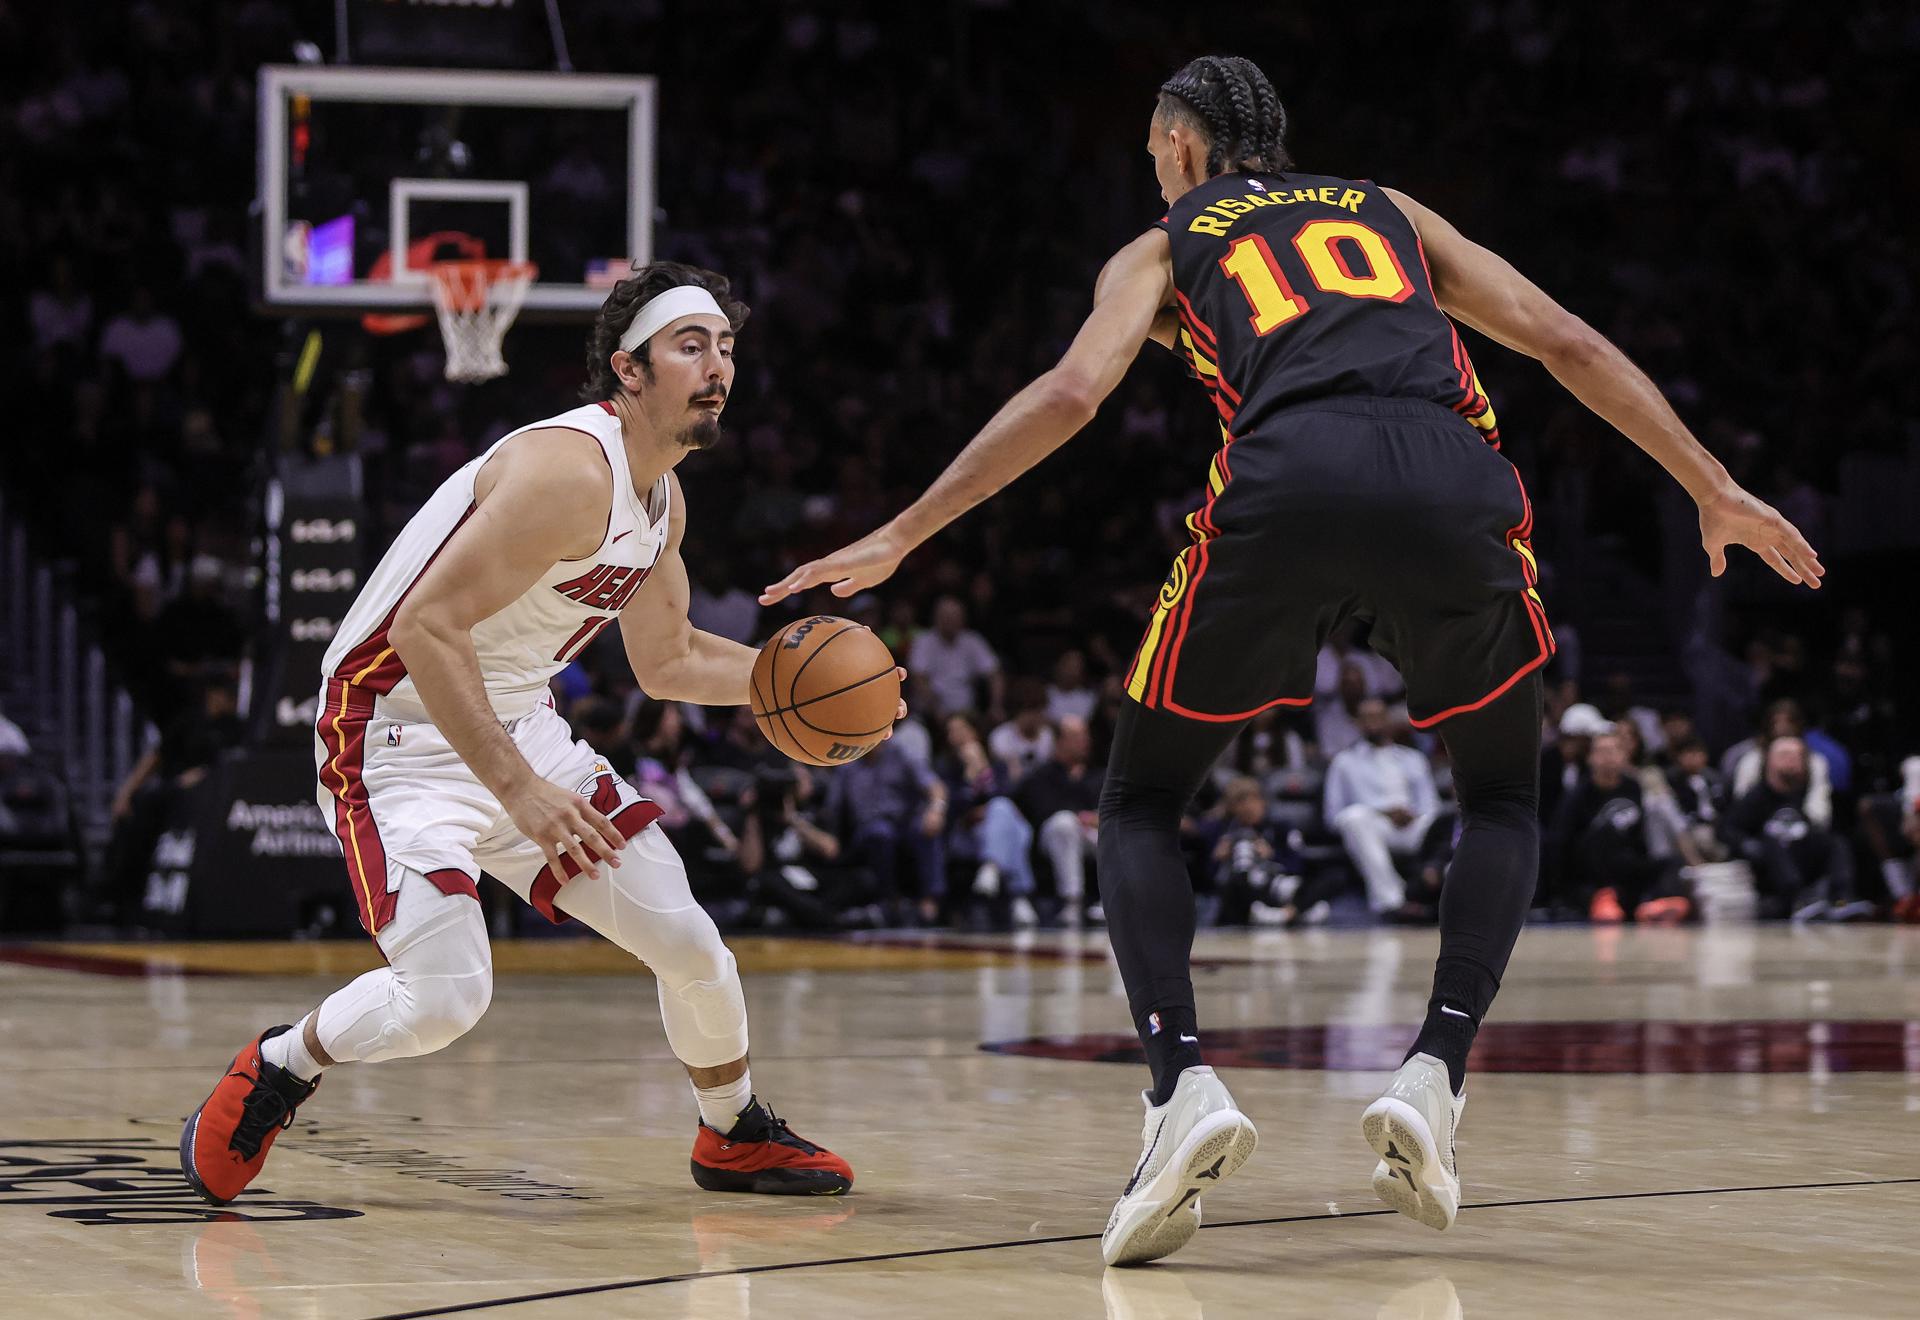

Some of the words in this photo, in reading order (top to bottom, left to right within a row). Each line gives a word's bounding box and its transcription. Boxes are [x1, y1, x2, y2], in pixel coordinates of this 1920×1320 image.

[1188, 187, 1366, 238] RISACHER
[1218, 218, 1416, 338] 10
[227, 799, 327, 831] Americ
[251, 828, 337, 858] Airline
[306, 1148, 466, 1168] Riley
[397, 1168, 592, 1191] Court
[500, 1192, 604, 1201] at
